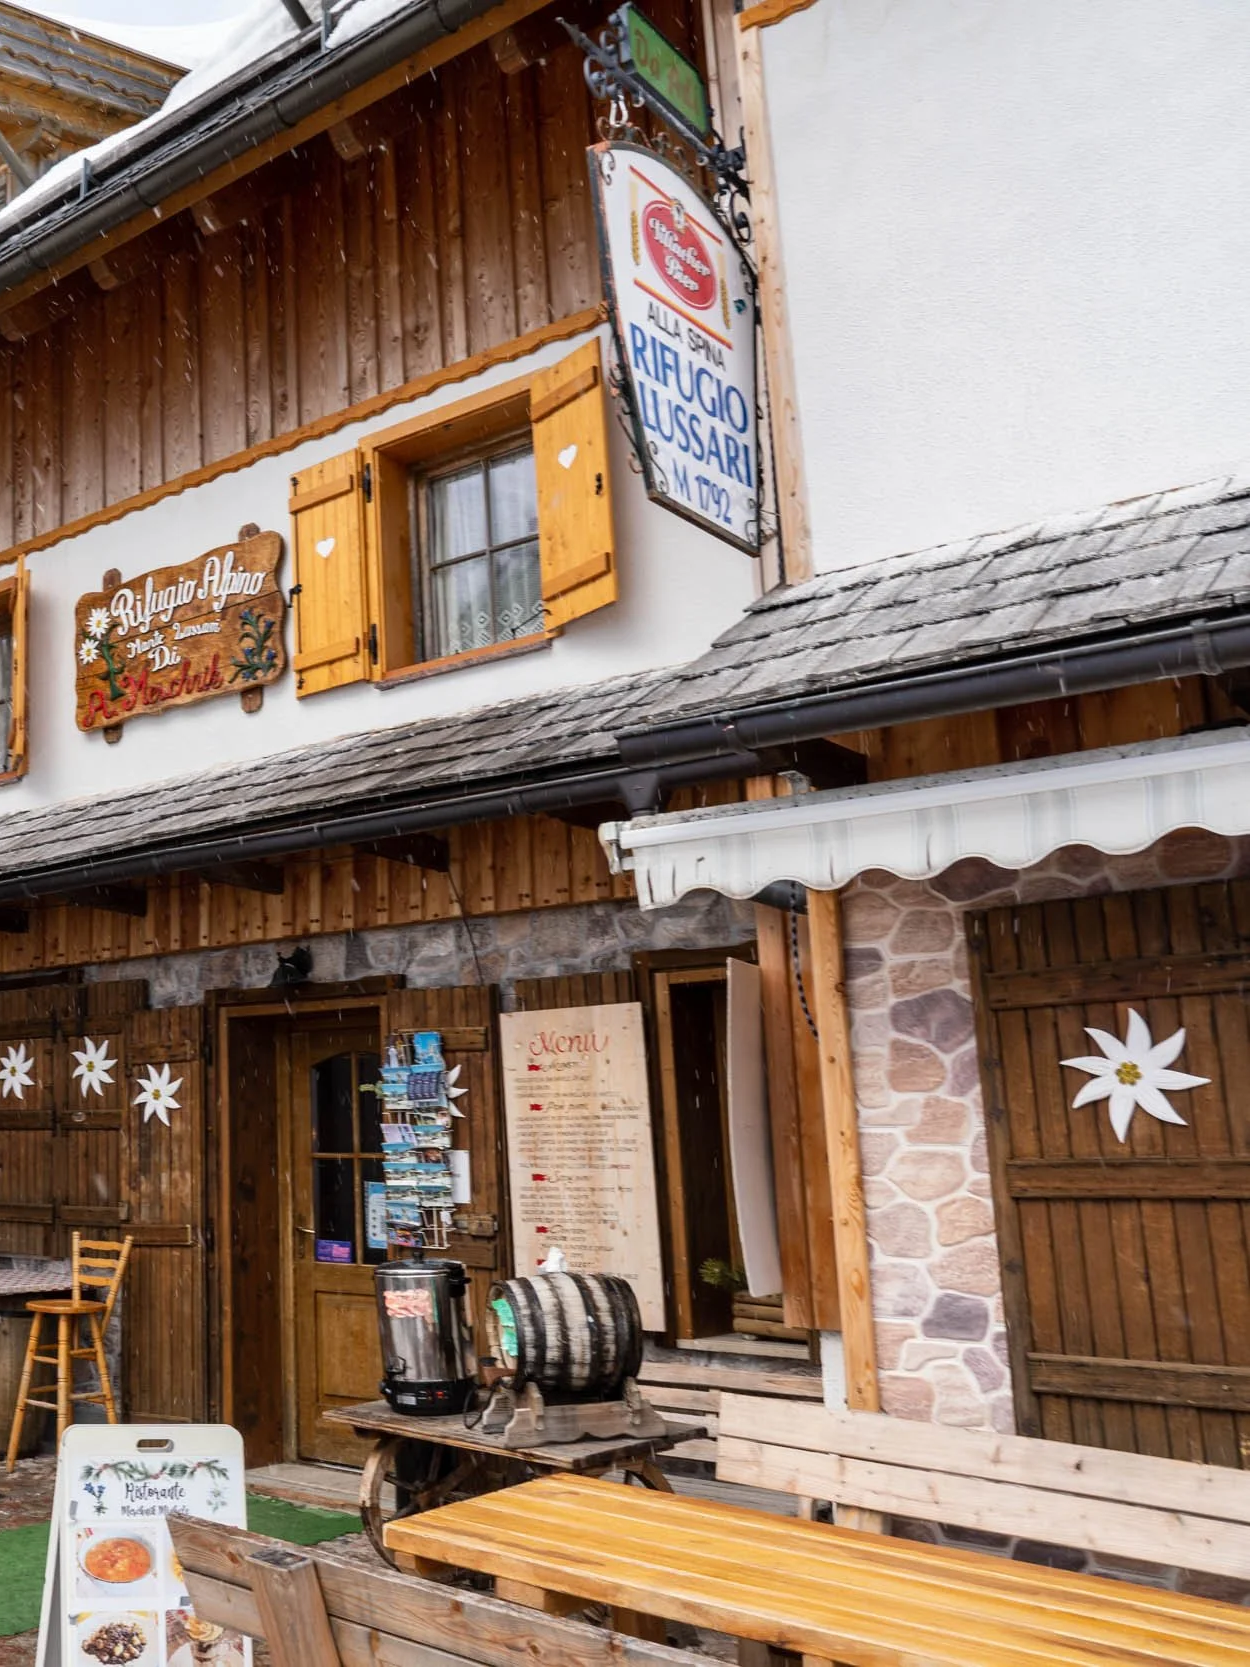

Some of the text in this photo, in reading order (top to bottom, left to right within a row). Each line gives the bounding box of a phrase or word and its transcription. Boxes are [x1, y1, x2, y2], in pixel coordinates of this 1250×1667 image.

[647, 301, 727, 371] ALLA SPINA
[629, 322, 748, 434] RIFUGIO
[638, 380, 753, 488] LUSSARI
[695, 474, 732, 525] 1792
[110, 551, 266, 636] Rifugio Alpino
[148, 646, 181, 672] Di
[125, 1481, 187, 1503] Ristorante
